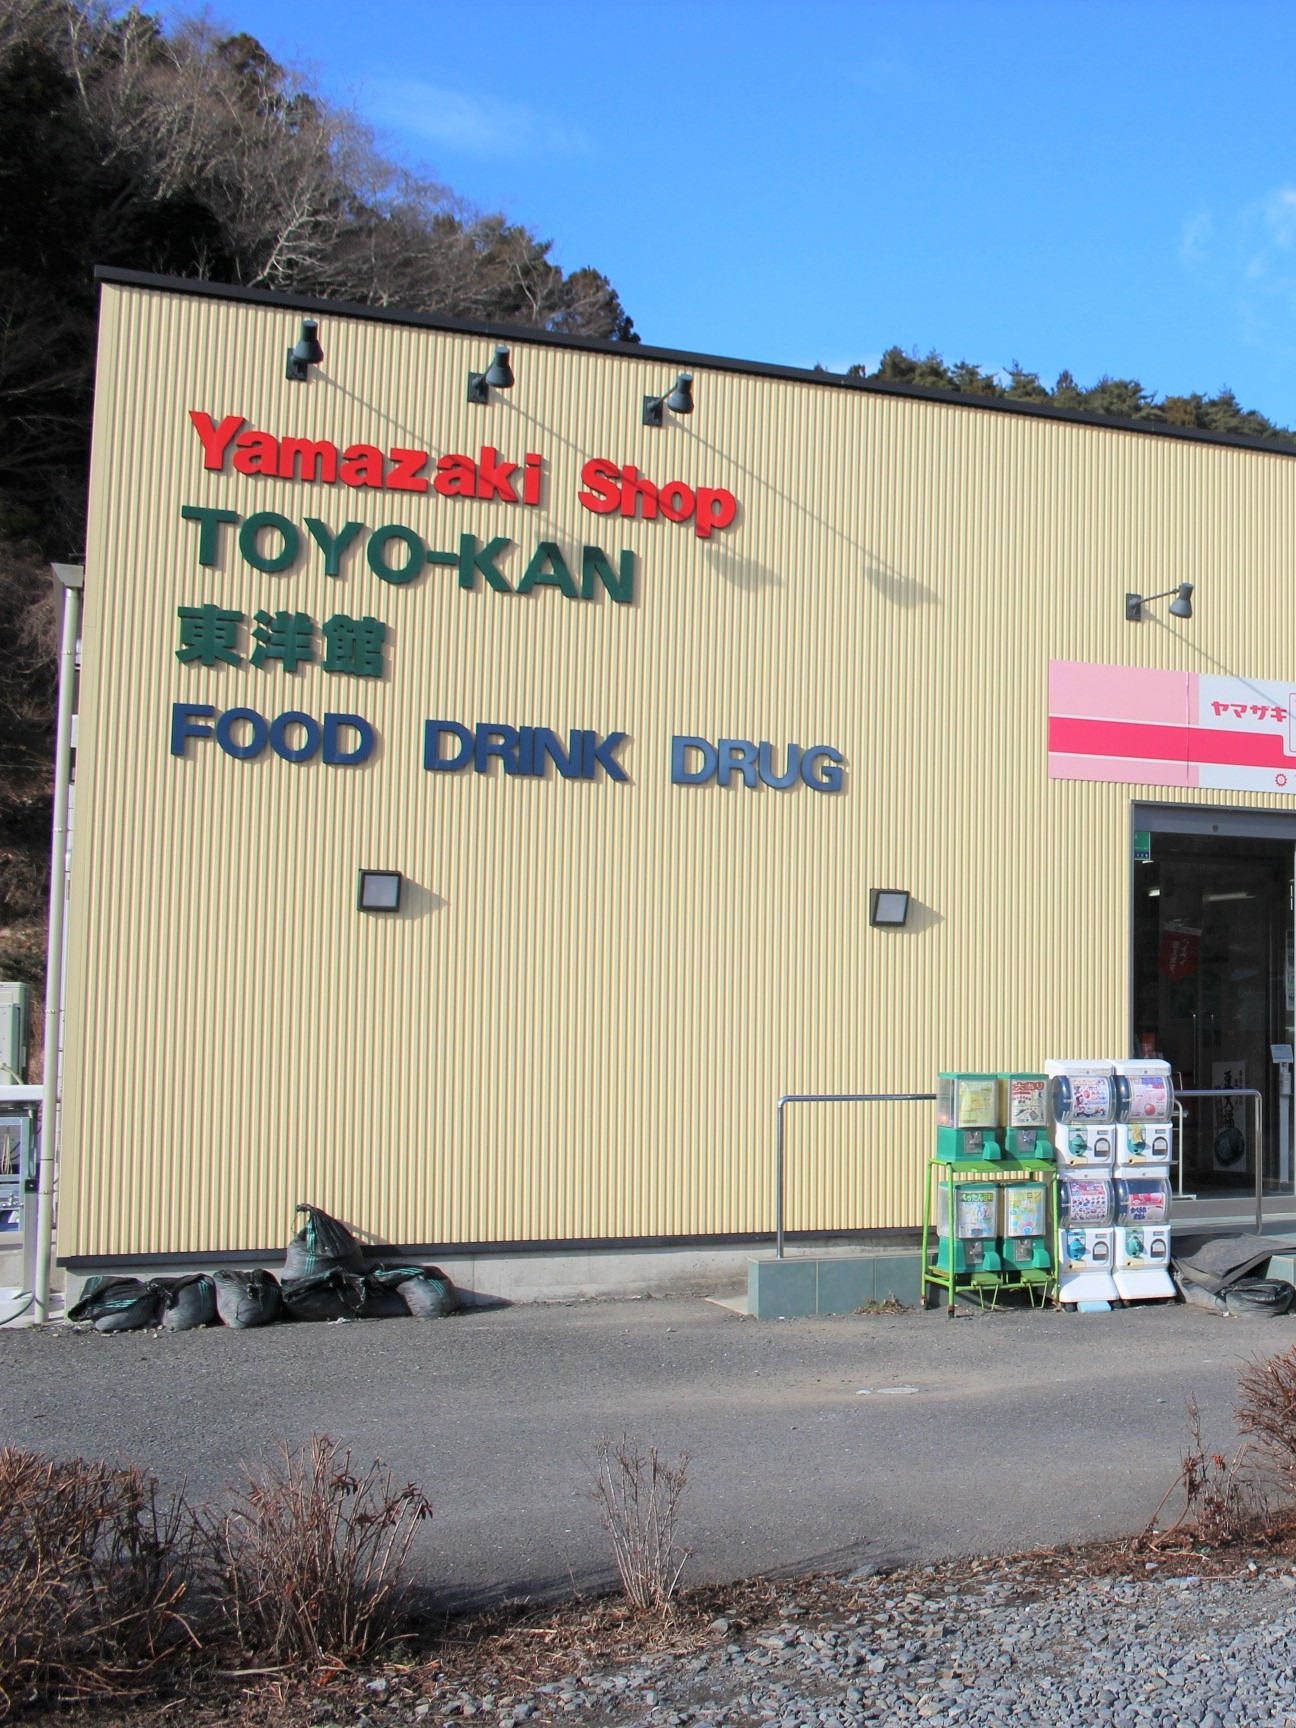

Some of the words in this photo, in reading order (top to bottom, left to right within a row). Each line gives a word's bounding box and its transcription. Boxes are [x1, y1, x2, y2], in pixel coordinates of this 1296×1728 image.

[189, 410, 546, 506] Yamazaki
[577, 456, 737, 538] Shop
[181, 505, 637, 605] TOYO-KAN
[175, 603, 387, 678] 東洋館
[170, 702, 377, 766] FOOD
[423, 719, 631, 782] DRINK
[671, 735, 846, 793] DRUG
[1211, 701, 1288, 723] ヤマザキ
